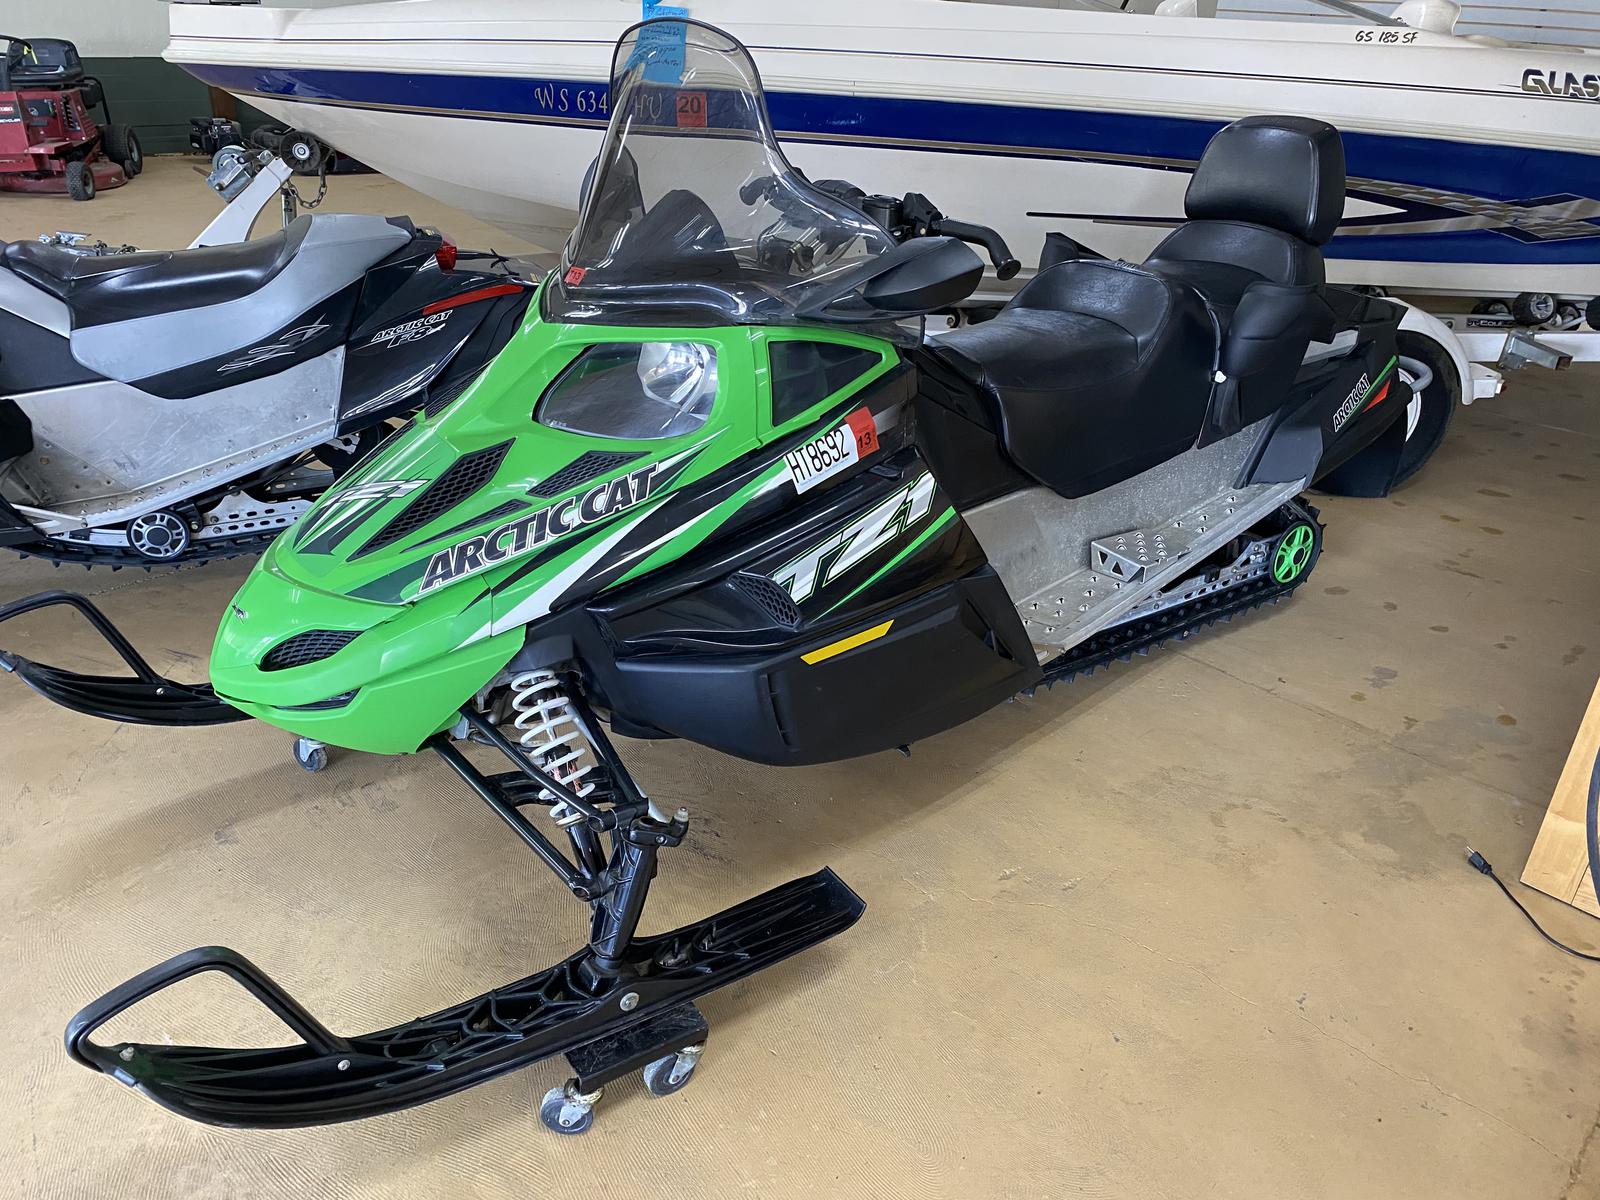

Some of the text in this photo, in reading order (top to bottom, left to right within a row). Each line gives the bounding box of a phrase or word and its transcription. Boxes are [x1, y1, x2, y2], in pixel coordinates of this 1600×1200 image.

[1355, 30, 1419, 44] GS 185 SF
[1521, 68, 1600, 98] GLAS
[677, 95, 702, 114] 20
[371, 309, 454, 343] ARCTIC CAT
[1332, 372, 1371, 433] ARCTIC CAT
[784, 428, 850, 484] HT8692
[858, 431, 872, 449] 13
[417, 462, 660, 595] ARCTIC CAT
